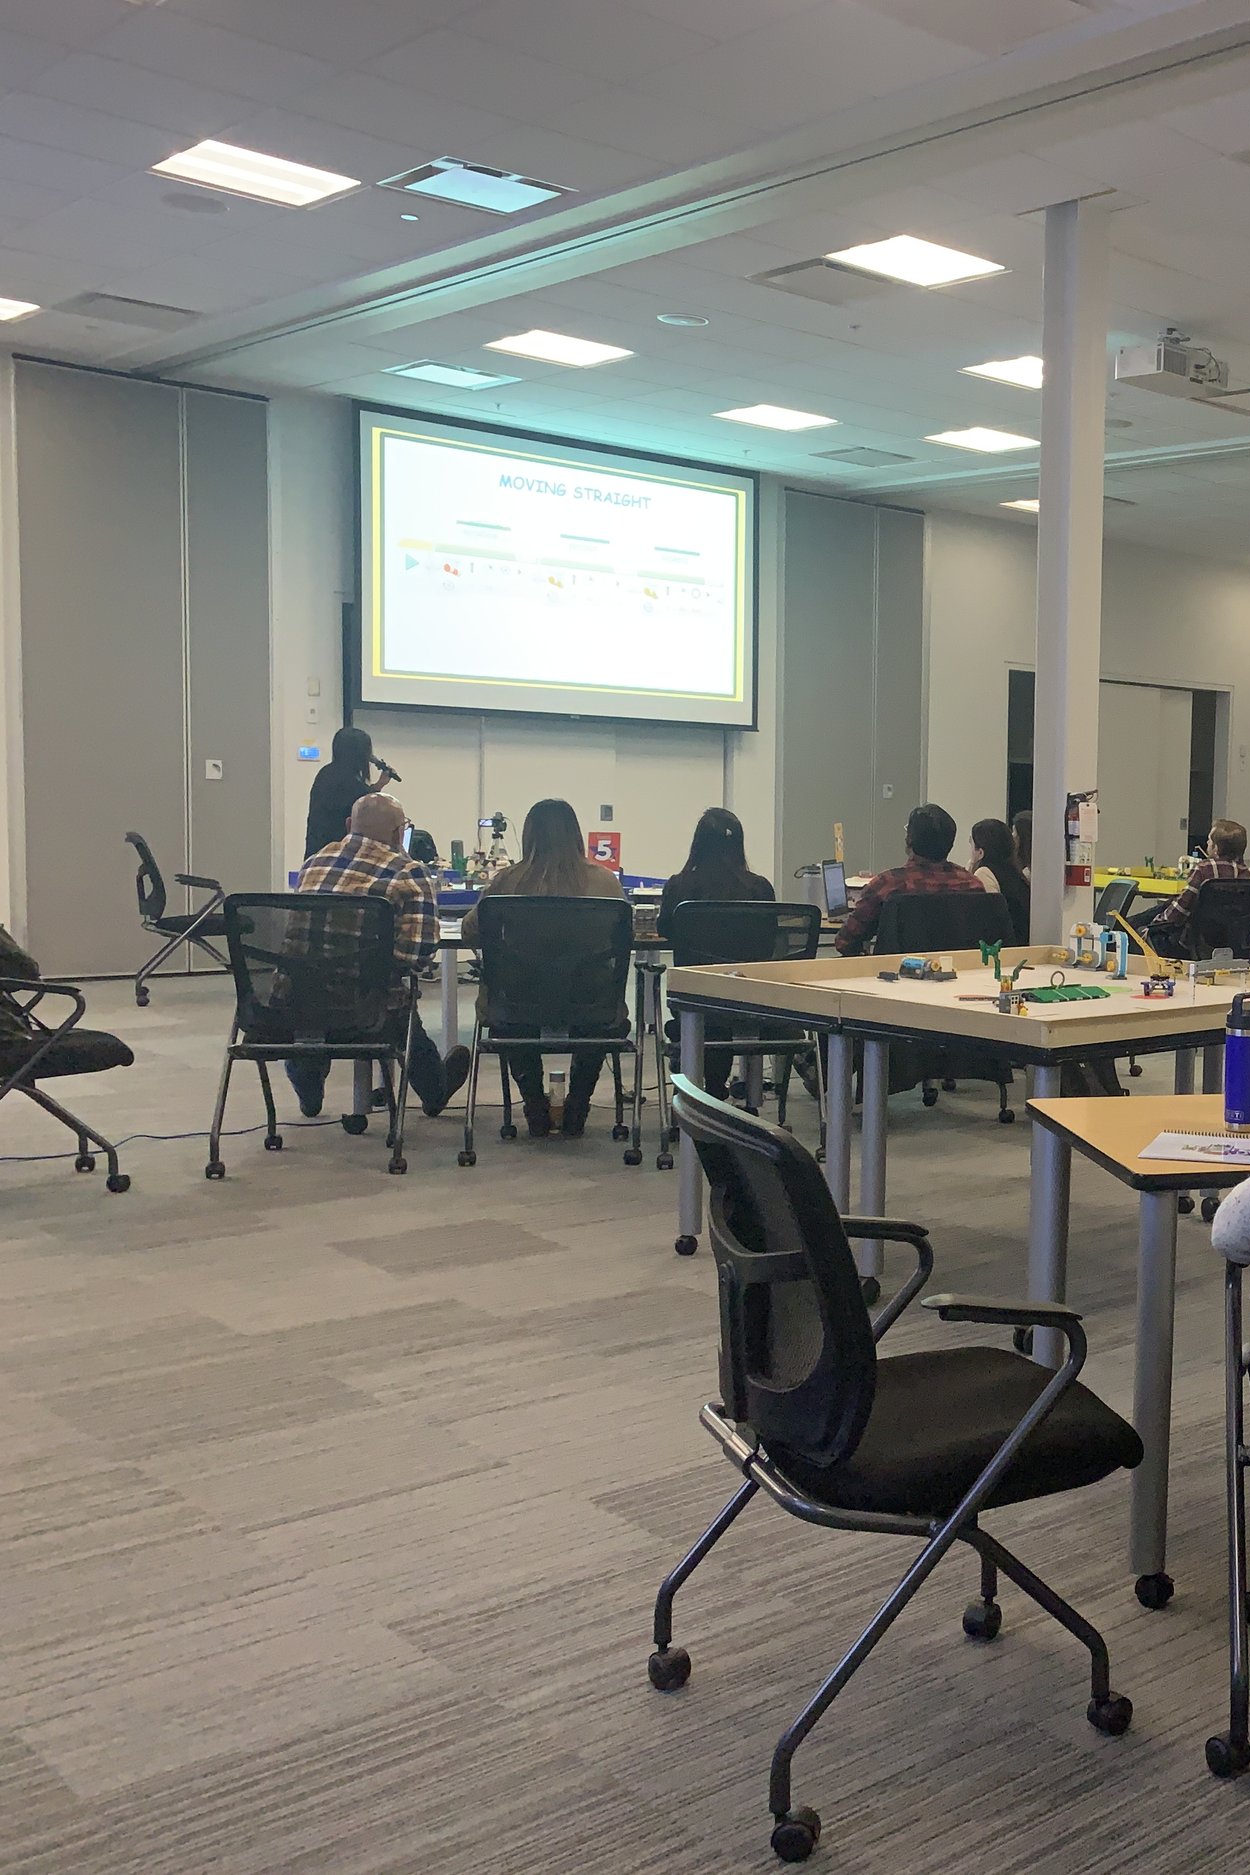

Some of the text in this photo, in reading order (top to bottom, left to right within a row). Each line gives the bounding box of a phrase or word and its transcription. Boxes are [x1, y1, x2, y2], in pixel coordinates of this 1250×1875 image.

[499, 474, 652, 509] MOVING STRAIGHT
[594, 840, 612, 861] 5
